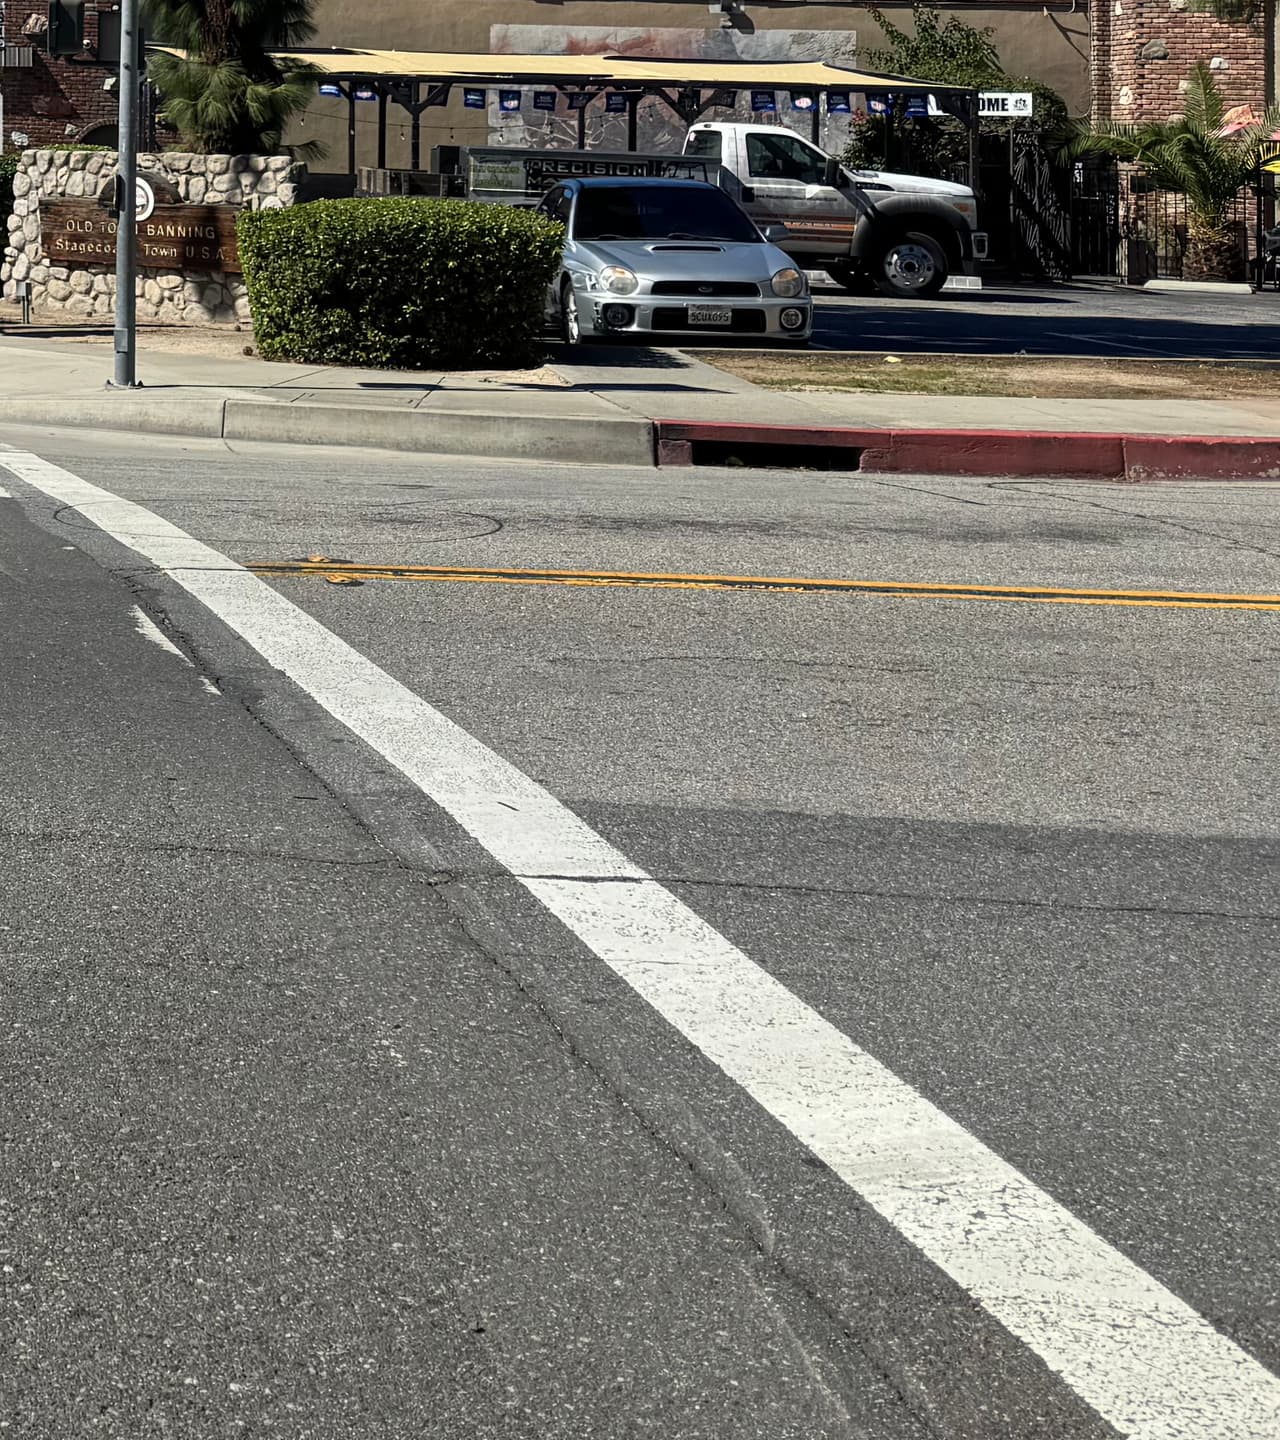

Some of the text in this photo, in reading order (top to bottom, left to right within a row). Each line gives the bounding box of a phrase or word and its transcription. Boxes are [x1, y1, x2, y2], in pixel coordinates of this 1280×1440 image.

[66, 219, 93, 234] OLD
[147, 224, 215, 239] BANNING
[56, 238, 117, 254] Stageco
[144, 243, 177, 257] Town
